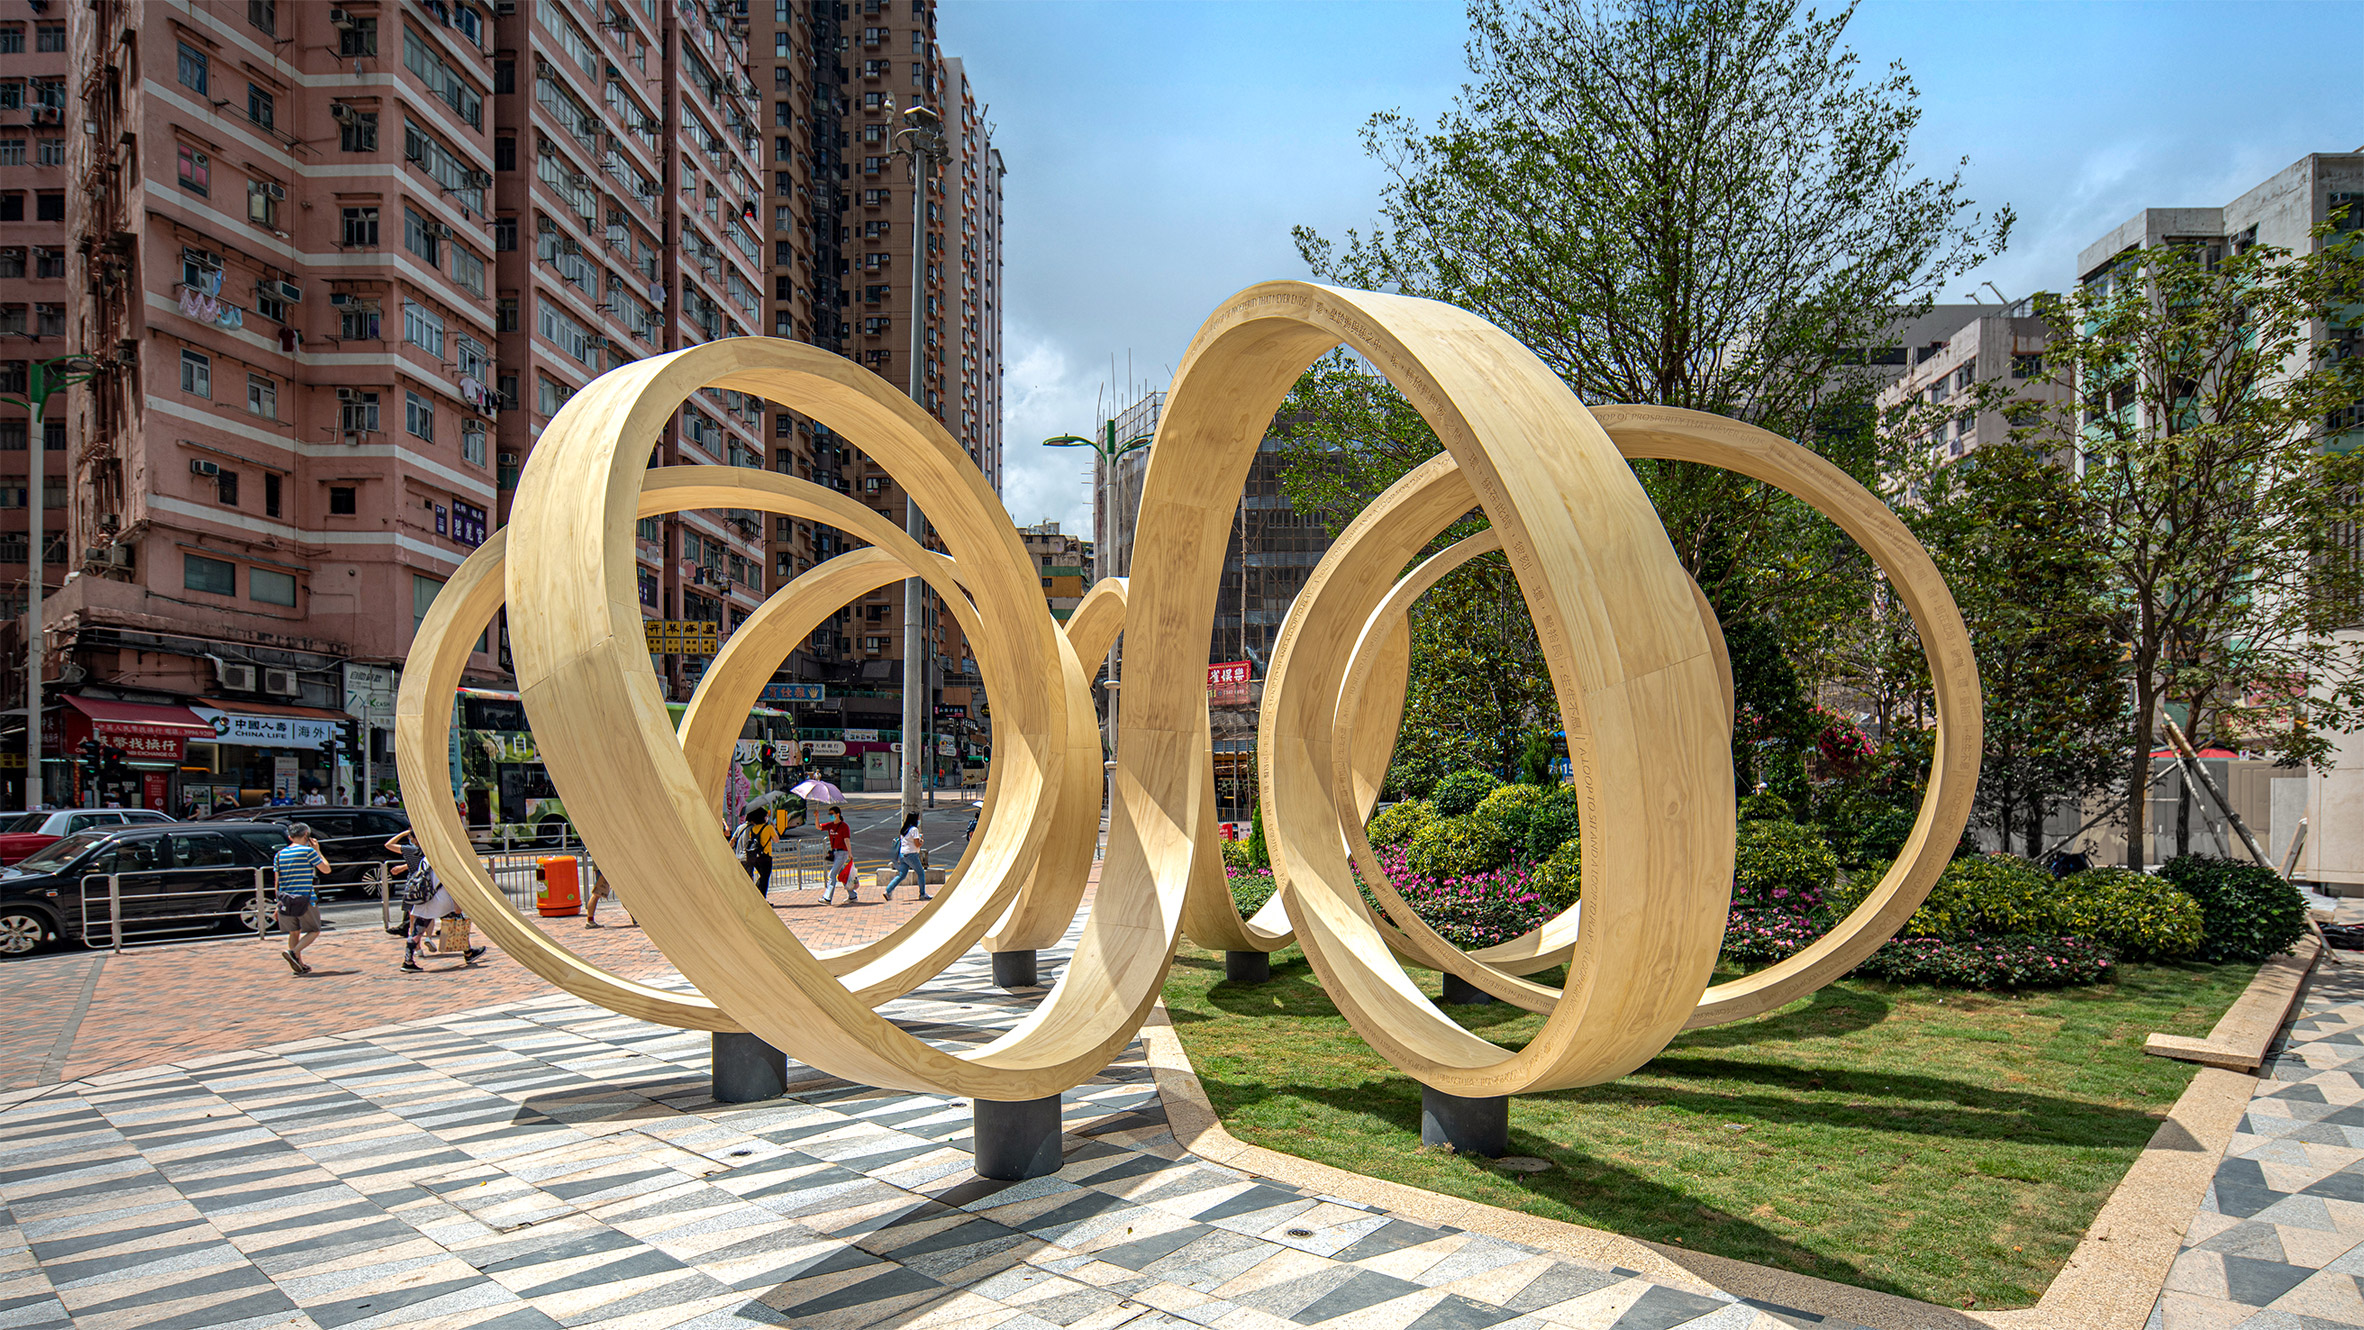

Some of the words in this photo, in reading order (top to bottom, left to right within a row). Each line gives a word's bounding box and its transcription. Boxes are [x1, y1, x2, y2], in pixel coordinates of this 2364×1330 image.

[1629, 411, 1686, 426] PROSPERITY
[1685, 417, 1709, 431] THAT
[1708, 422, 1741, 439] NEVER
[1738, 431, 1766, 448] ENDS
[1315, 557, 1334, 580] LOOP
[1339, 524, 1361, 548] NIGHT
[1357, 510, 1374, 528] AND
[1375, 490, 1396, 510] LOOP
[1557, 670, 1584, 731] 生生不息
[235, 718, 288, 733] 中國人壽
[235, 730, 265, 738] CHINA
[298, 725, 326, 739] 海外
[138, 750, 168, 758] EXCHANGE
[1579, 756, 1594, 795] LOOP
[1585, 794, 1597, 813] TO
[1949, 786, 1965, 810] LOOP
[1589, 830, 1599, 859] AND
[1919, 856, 1939, 881] LOOP
[1588, 868, 1599, 900] LOOP
[1587, 899, 1598, 917] TO
[1584, 914, 1597, 942] PLAY
[1874, 914, 1898, 938] LOOP
